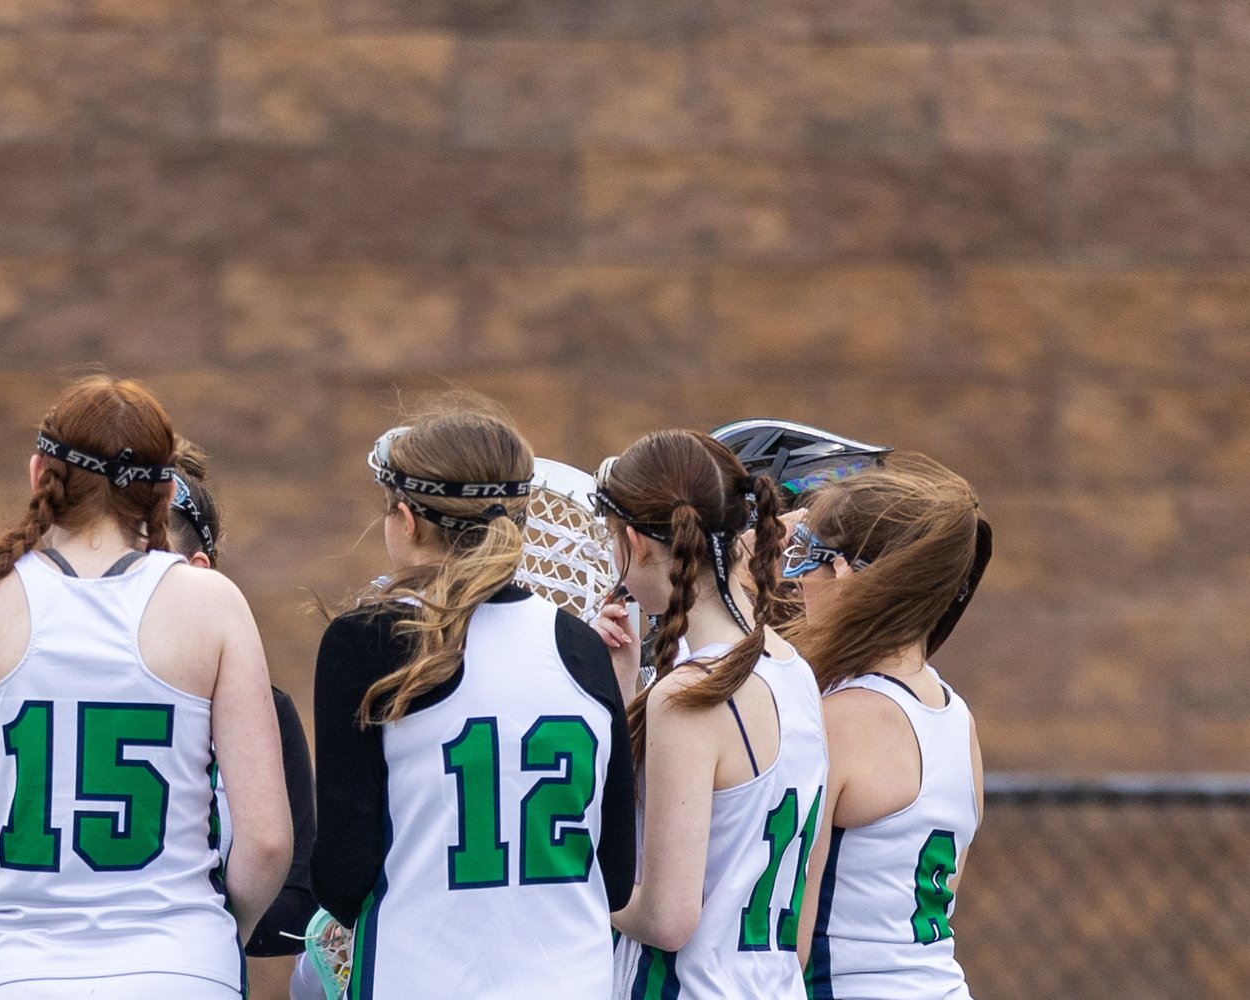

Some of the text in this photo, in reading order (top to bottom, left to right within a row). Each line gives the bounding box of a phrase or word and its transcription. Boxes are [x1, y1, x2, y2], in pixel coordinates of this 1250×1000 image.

[66, 450, 108, 474] STX
[160, 467, 175, 480] ST
[380, 468, 531, 497] TX STX STX ST
[186, 497, 202, 521] TX
[441, 714, 599, 891] 12
[737, 785, 823, 952] 11
